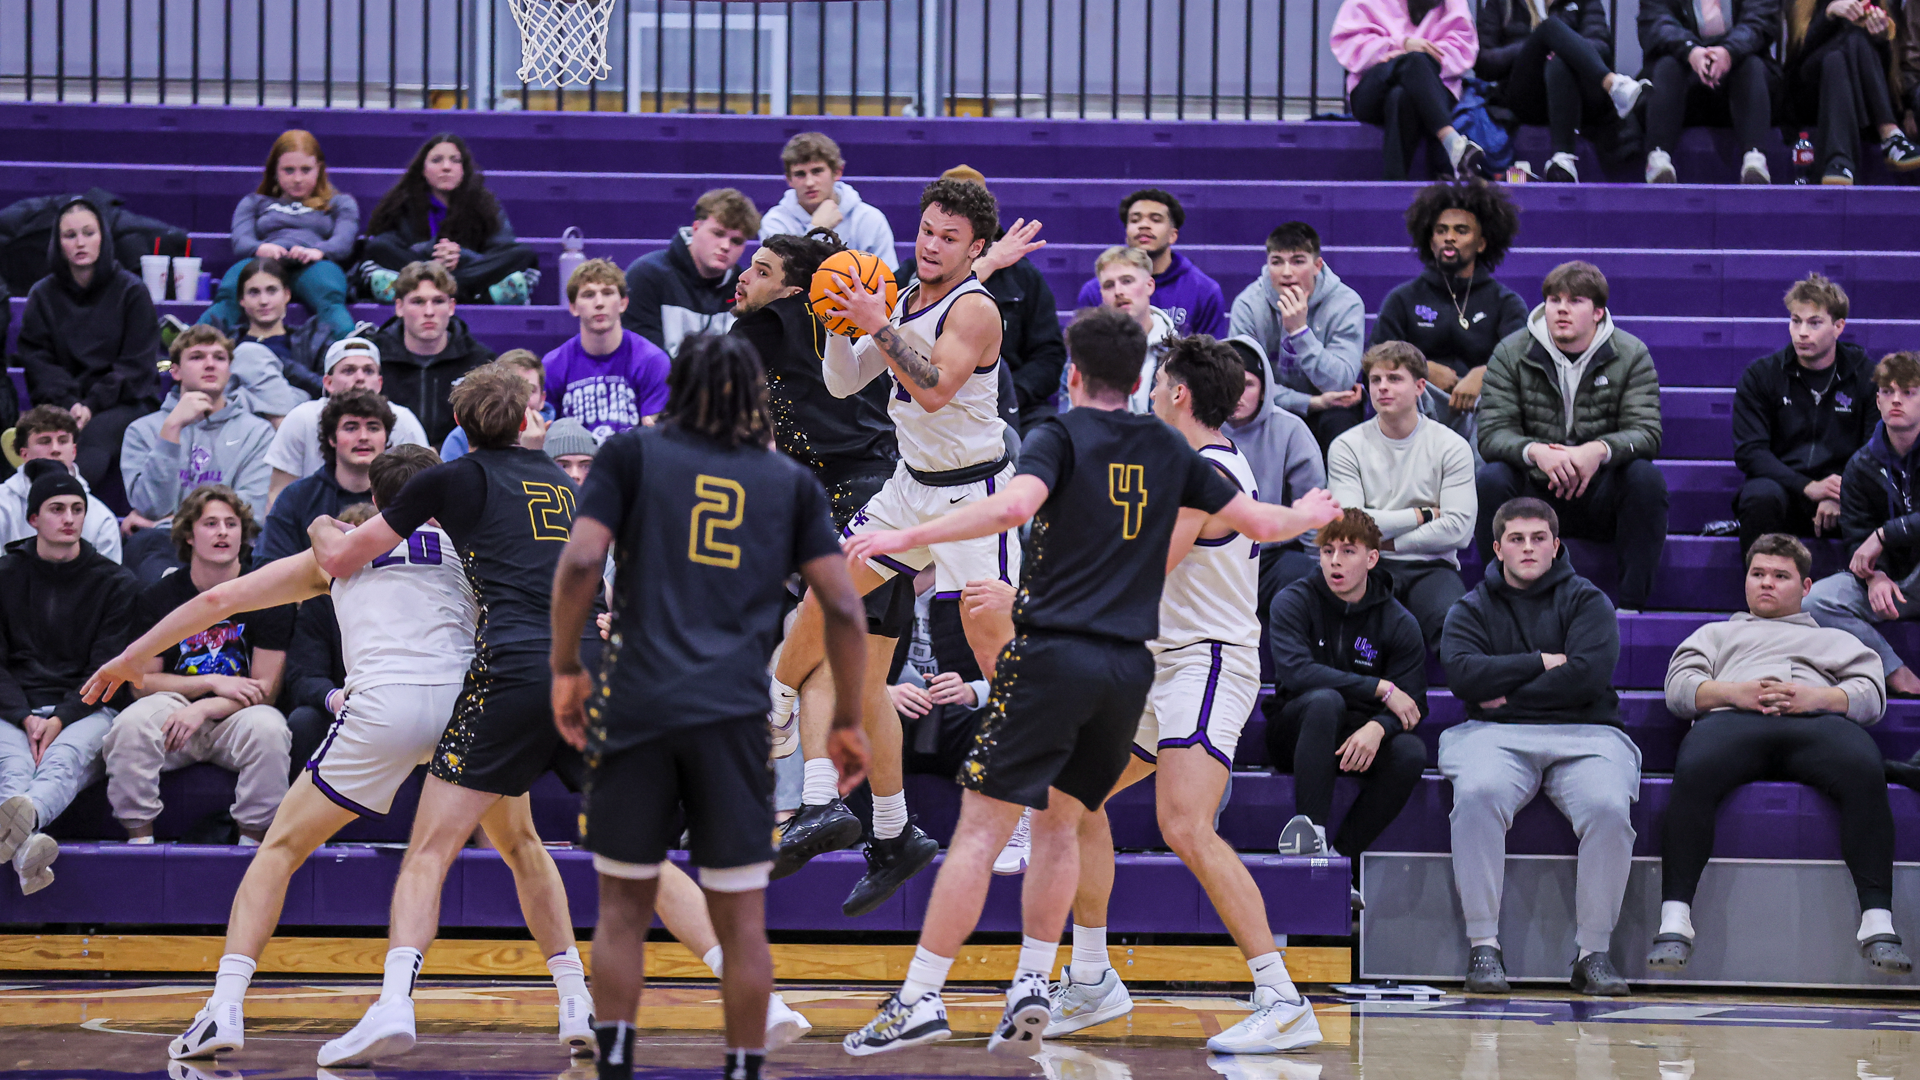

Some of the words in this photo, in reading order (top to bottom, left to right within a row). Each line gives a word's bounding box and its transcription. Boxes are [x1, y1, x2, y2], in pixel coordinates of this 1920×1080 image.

[562, 382, 640, 425] COUGARS
[688, 473, 746, 570] 2
[1108, 463, 1148, 540] 4
[1354, 636, 1378, 661] USF
